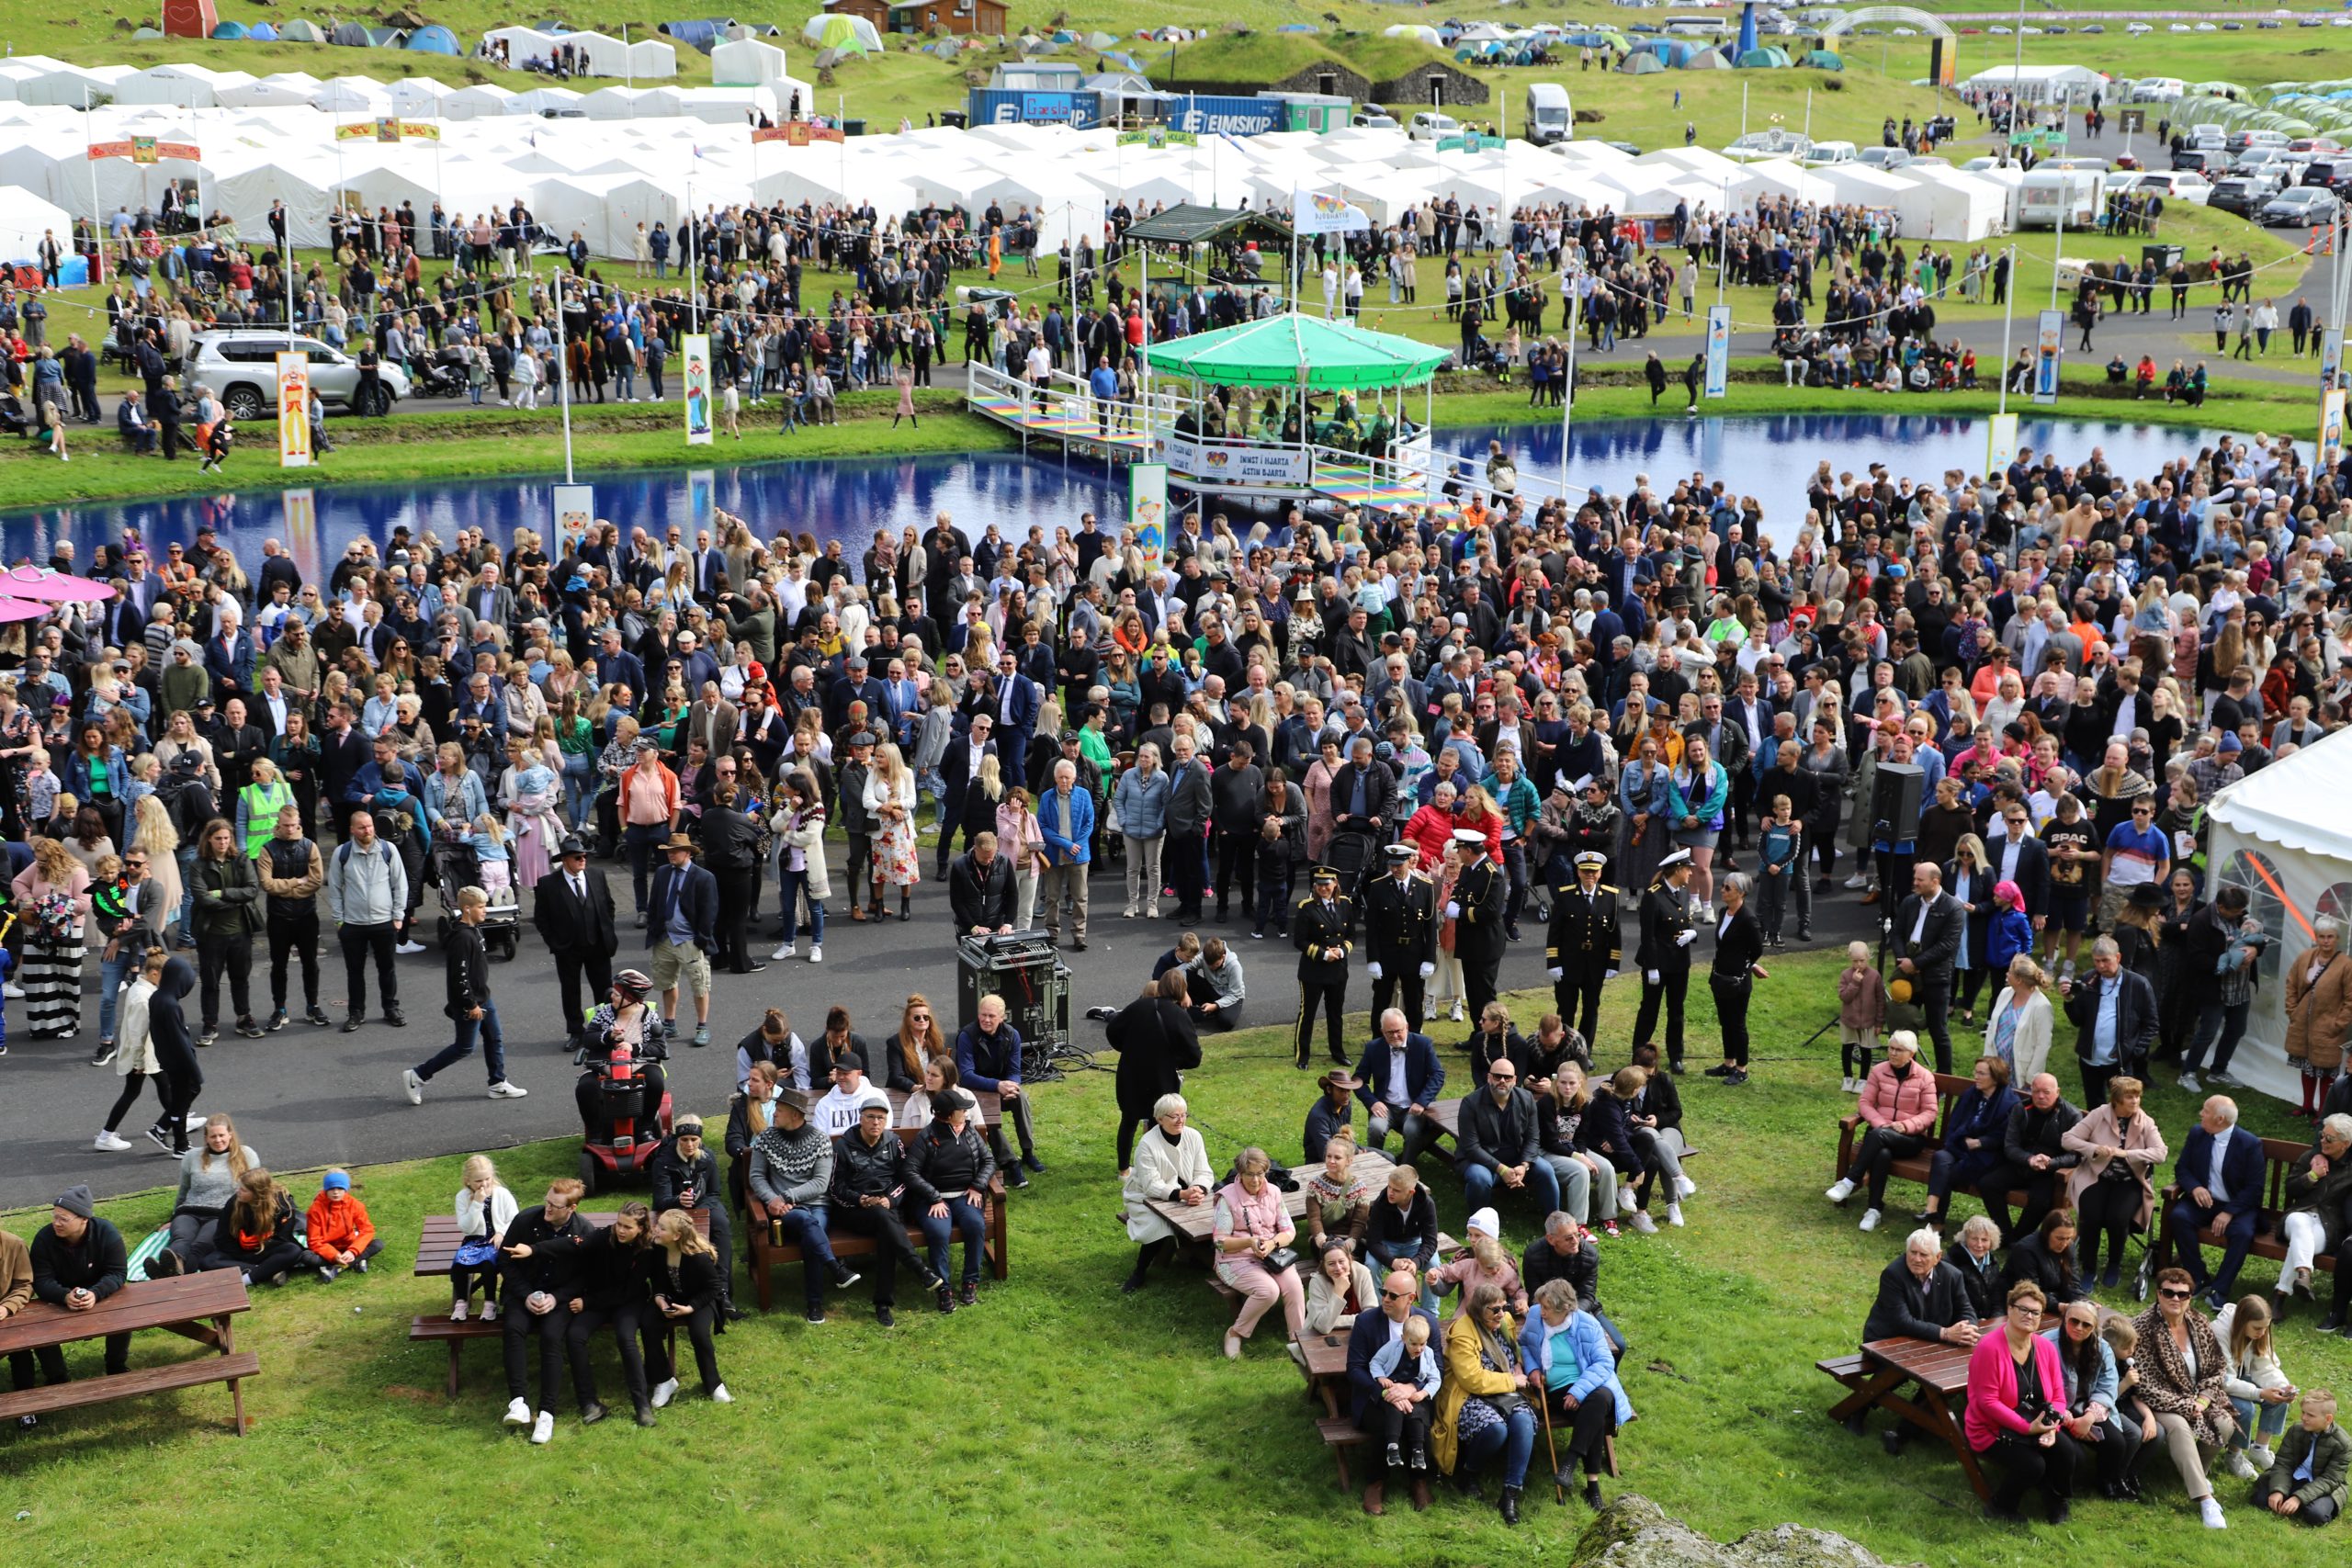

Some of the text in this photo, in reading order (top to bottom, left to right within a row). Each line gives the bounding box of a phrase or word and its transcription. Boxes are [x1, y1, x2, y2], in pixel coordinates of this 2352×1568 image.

[1027, 98, 1069, 115] Gæsla
[1208, 115, 1272, 133] EIMSKIP
[1264, 457, 1289, 466] HJARTA
[1262, 468, 1287, 478] BJARTA
[2051, 833, 2087, 844] 2PAC
